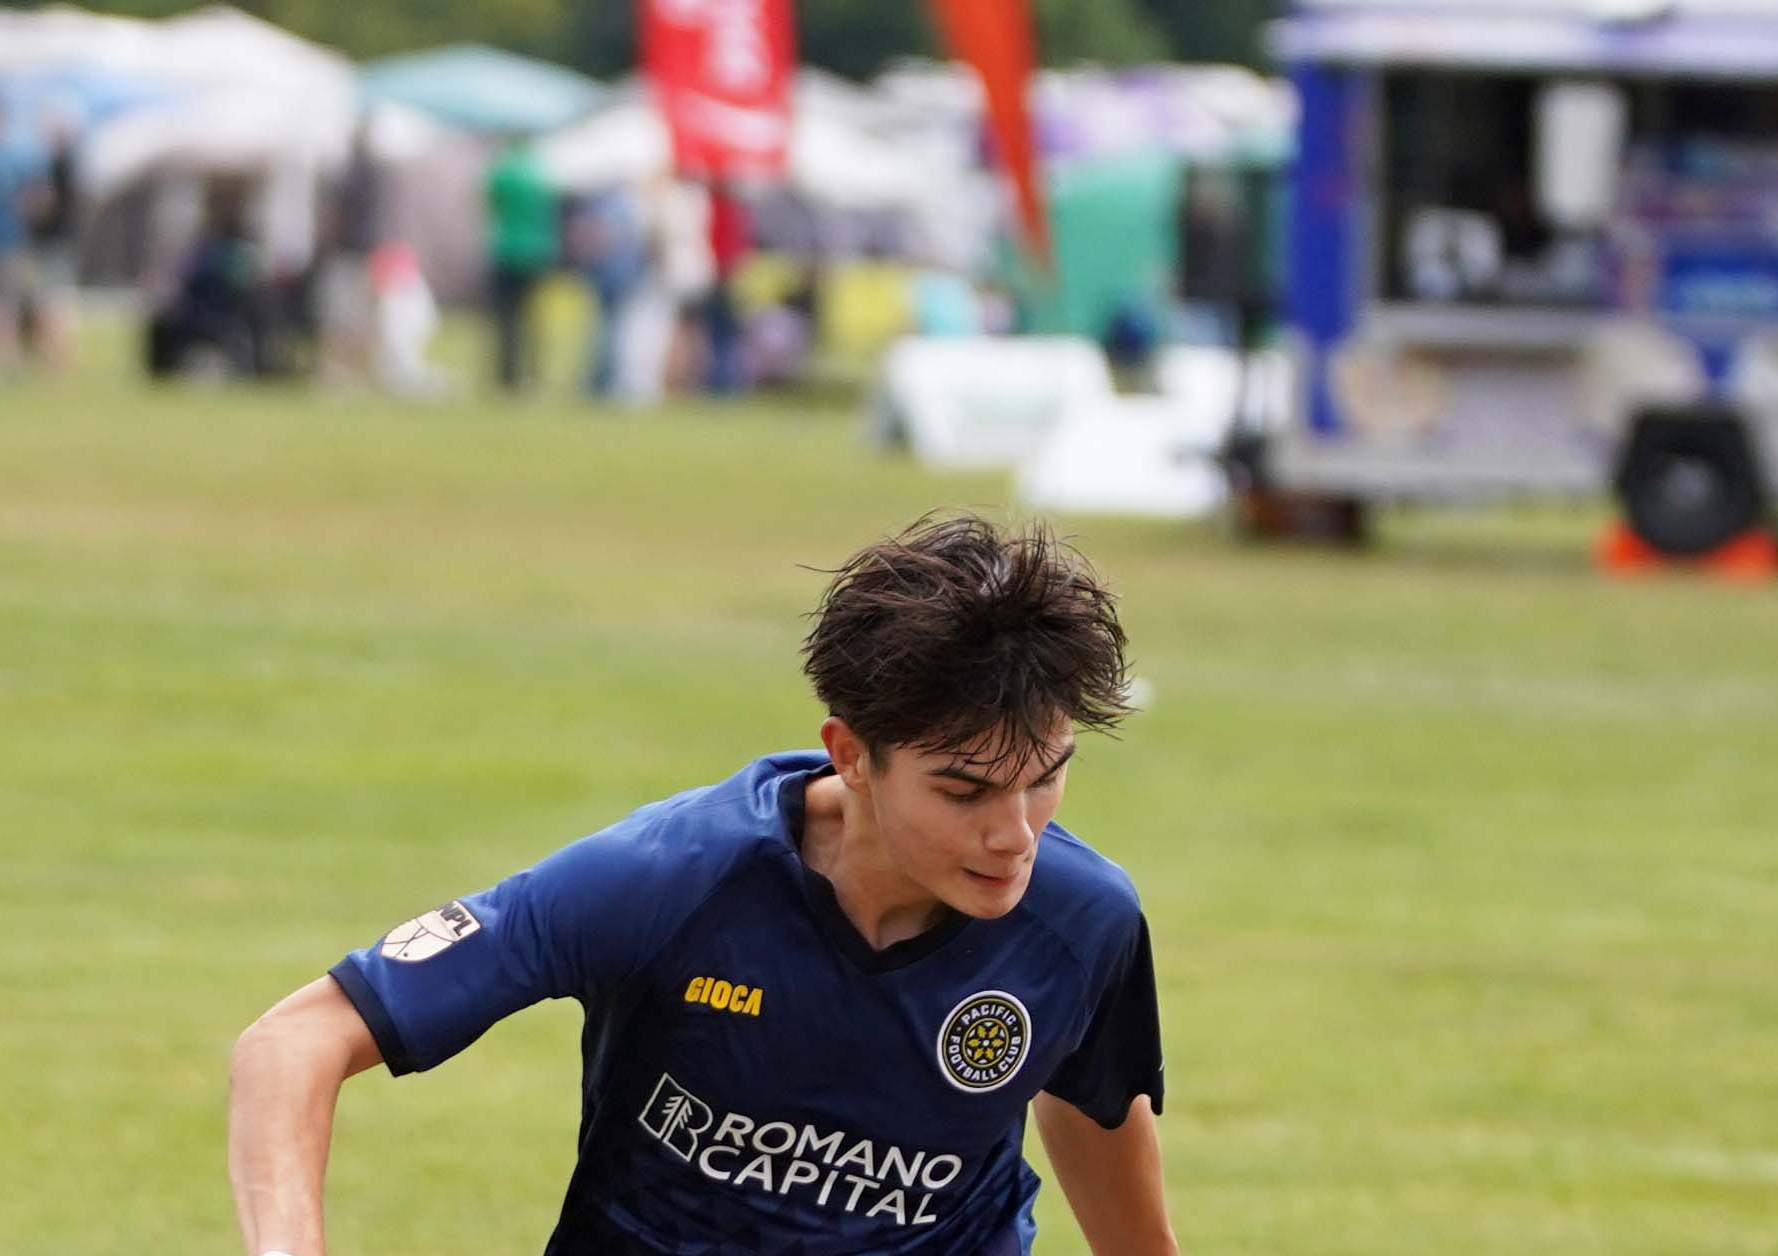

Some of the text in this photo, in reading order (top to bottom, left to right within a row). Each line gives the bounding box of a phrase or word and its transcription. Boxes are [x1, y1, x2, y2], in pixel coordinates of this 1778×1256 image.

[684, 976, 763, 1016] GIOCA
[961, 1004, 1017, 1026] PACIFIC
[949, 1035, 1021, 1080] FOOTBALL CLUB
[713, 1112, 963, 1189] ROMANO
[698, 1145, 937, 1225] CAPITAL
